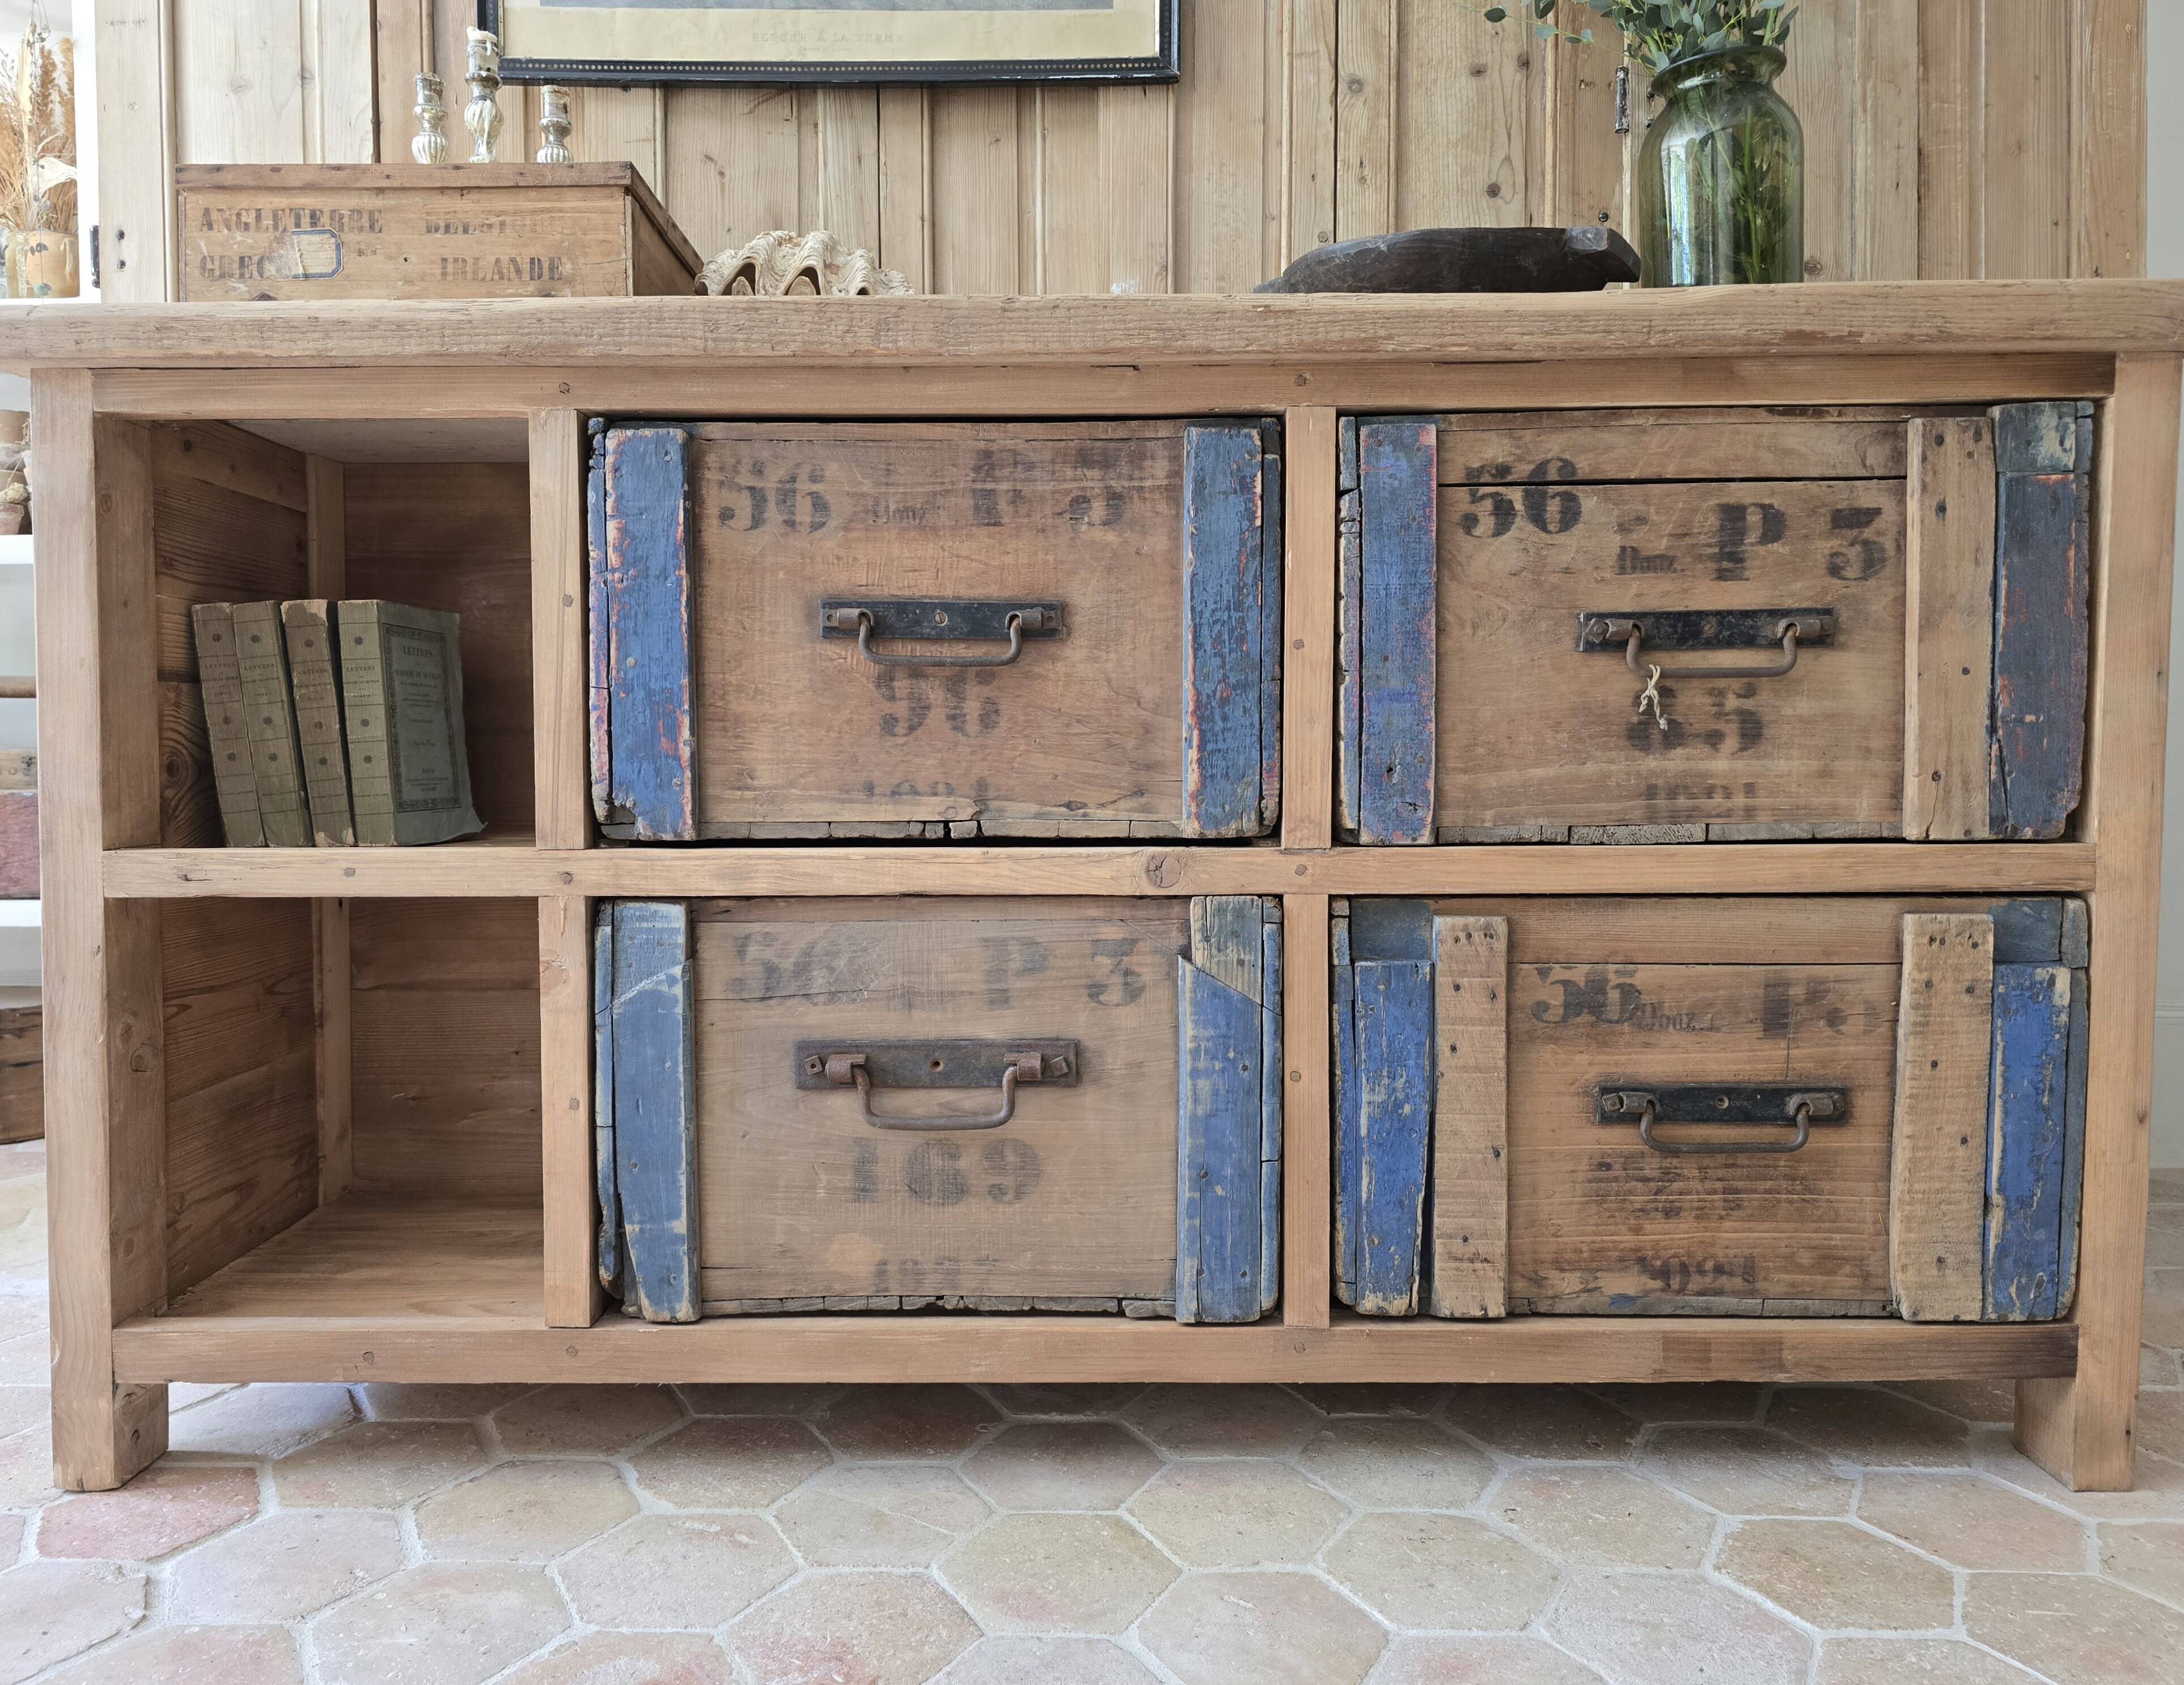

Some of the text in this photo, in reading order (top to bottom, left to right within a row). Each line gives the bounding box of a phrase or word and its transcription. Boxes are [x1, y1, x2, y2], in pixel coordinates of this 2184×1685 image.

[752, 32, 807, 42] RETOUR
[833, 33, 849, 42] LA
[856, 33, 903, 43] FERME
[199, 208, 383, 234] ANGLETERRE
[440, 256, 563, 281] IRLANDE
[718, 458, 832, 534] 56
[1459, 456, 1582, 538] 56
[1710, 502, 1786, 582] P
[403, 646, 433, 658] LETTRES
[1530, 955, 1643, 1024] 56
